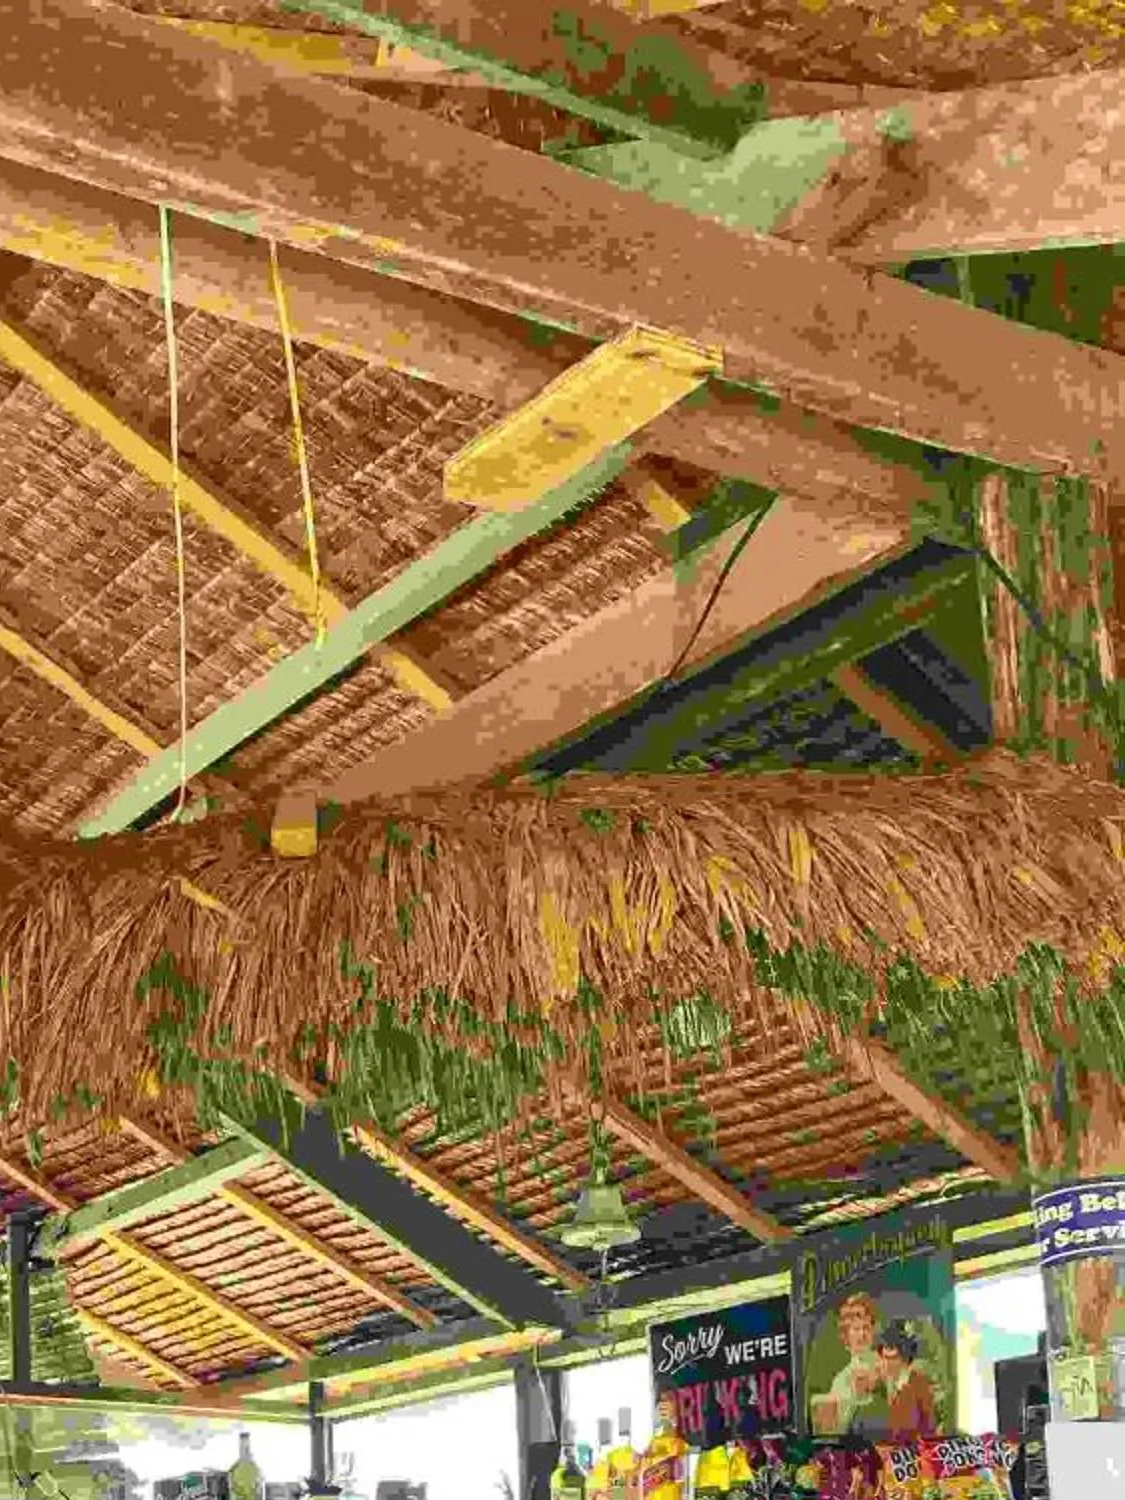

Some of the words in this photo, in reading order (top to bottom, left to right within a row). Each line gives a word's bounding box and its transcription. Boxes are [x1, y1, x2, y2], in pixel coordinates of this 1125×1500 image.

[1035, 1200, 1074, 1229] ing
[658, 1324, 724, 1372] Sorry
[725, 1333, 787, 1365] WE'RE
[663, 1369, 788, 1432] RIKNG
